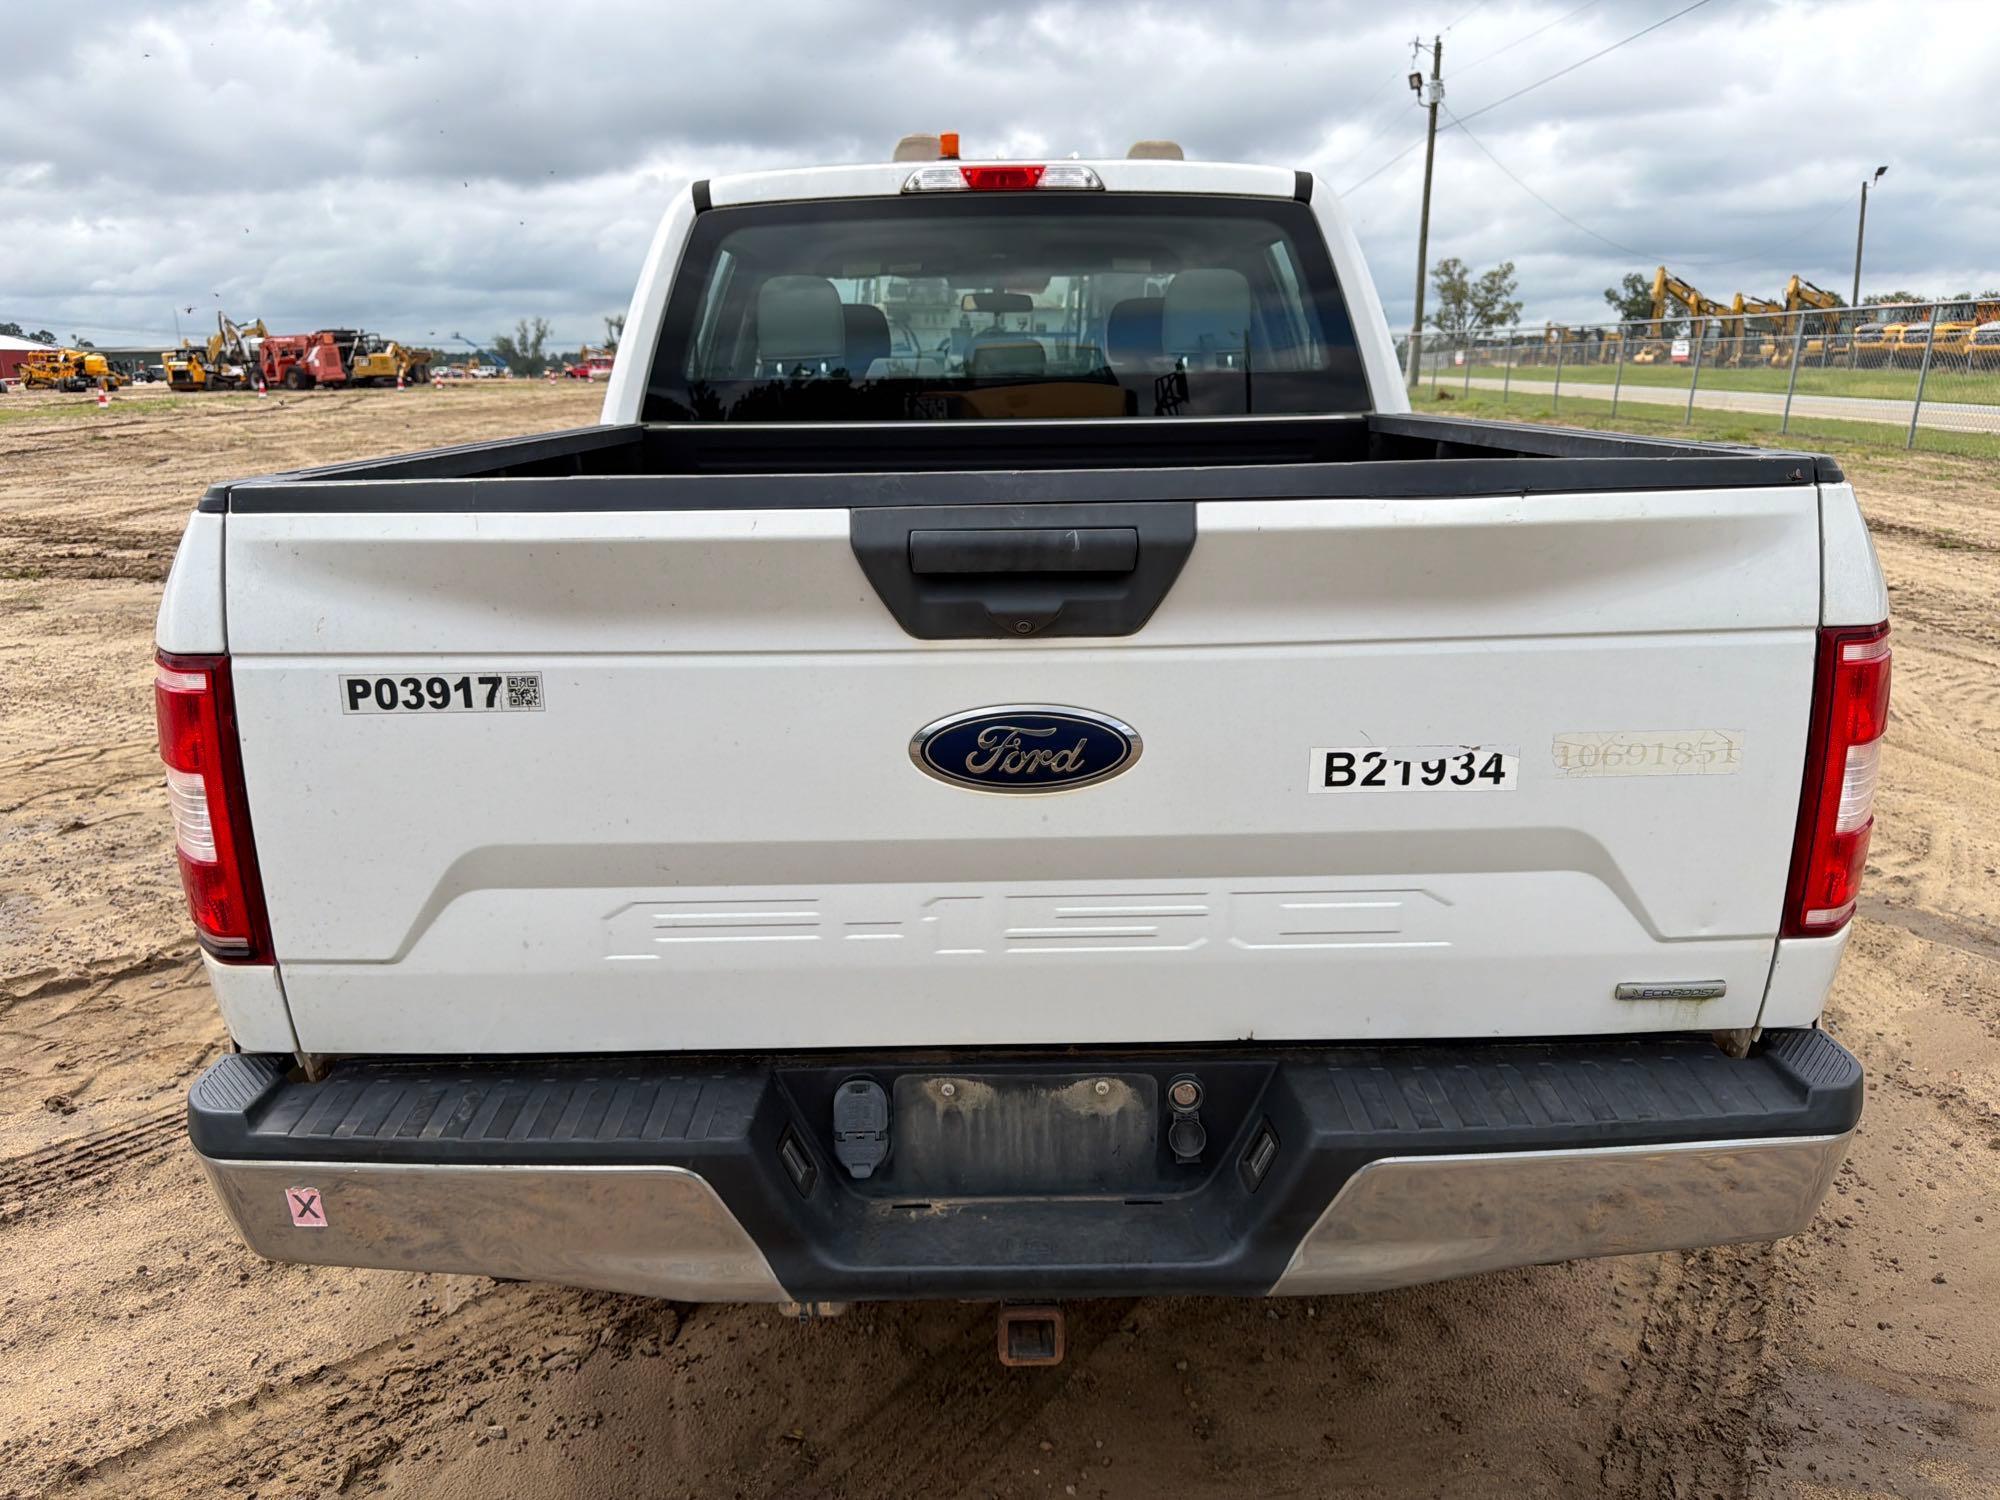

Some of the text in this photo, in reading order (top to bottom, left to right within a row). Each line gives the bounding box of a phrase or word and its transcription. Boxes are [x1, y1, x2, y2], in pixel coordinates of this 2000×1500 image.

[347, 676, 502, 711] P03917
[966, 725, 1088, 774] Ford
[1559, 740, 1738, 768] 10691851
[1324, 751, 1506, 787] B21934
[291, 1194, 321, 1218] X
